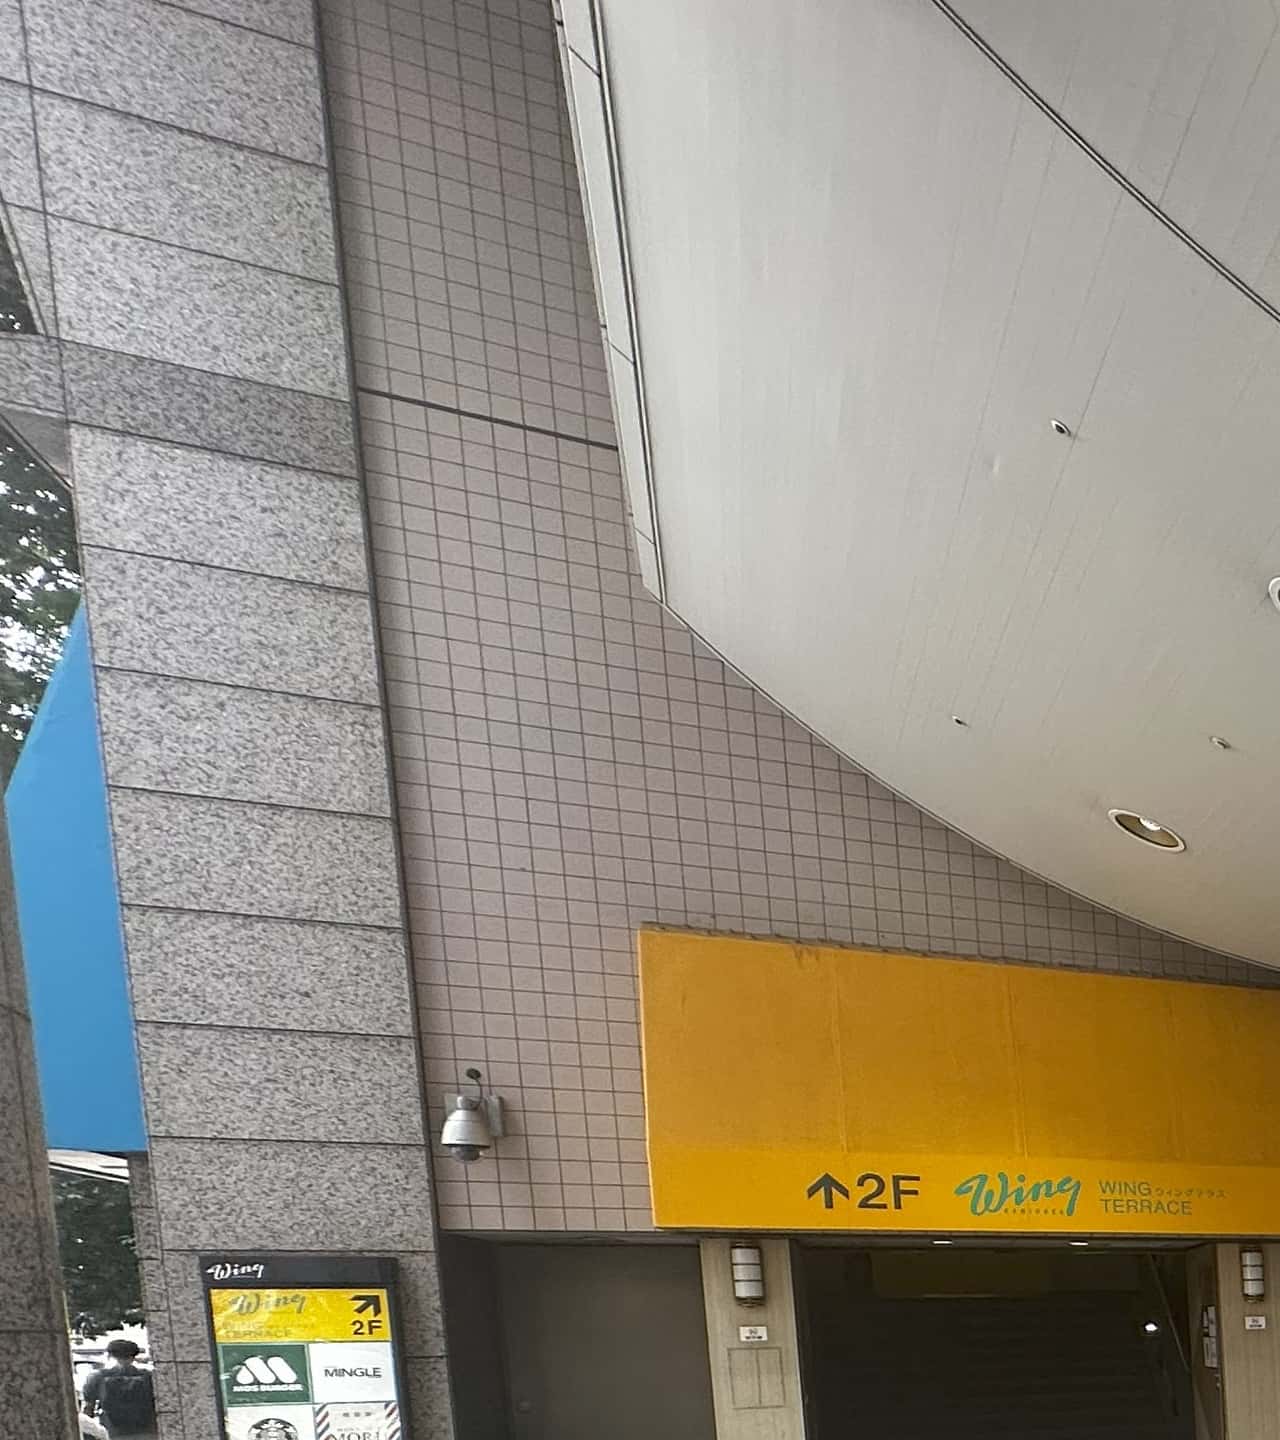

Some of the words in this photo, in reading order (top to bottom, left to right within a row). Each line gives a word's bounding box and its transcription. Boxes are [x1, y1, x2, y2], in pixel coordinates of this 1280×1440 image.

[855, 1173, 921, 1210] 2F
[954, 1171, 1081, 1216] Wing
[1099, 1180, 1152, 1196] WING
[1100, 1199, 1193, 1216] TERRACE
[206, 1263, 264, 1280] Wing
[351, 1319, 383, 1336] 2F
[324, 1367, 382, 1379] MINGLE
